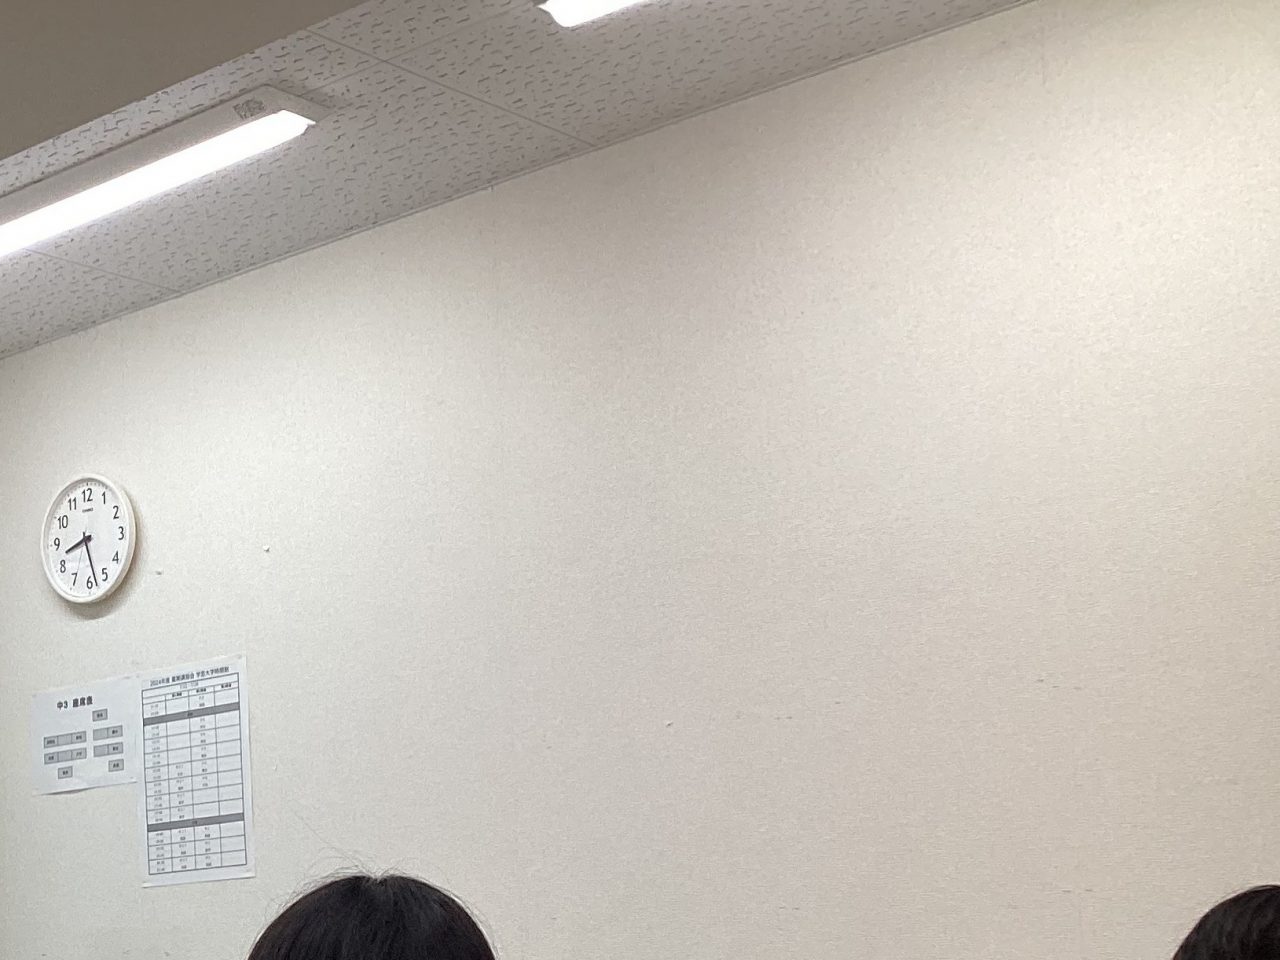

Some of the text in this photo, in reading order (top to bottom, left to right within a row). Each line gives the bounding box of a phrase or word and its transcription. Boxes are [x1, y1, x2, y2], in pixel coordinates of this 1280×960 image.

[82, 488, 93, 503] 12
[101, 491, 106, 505] 1
[68, 497, 77, 511] 11
[112, 505, 119, 519] 2
[57, 515, 68, 529] 10
[118, 526, 125, 540] 3
[54, 537, 60, 551] 9
[112, 550, 119, 564] 4
[59, 559, 66, 573] 8
[71, 572, 78, 586] 7
[101, 567, 108, 582] 5
[86, 576, 93, 589] 6
